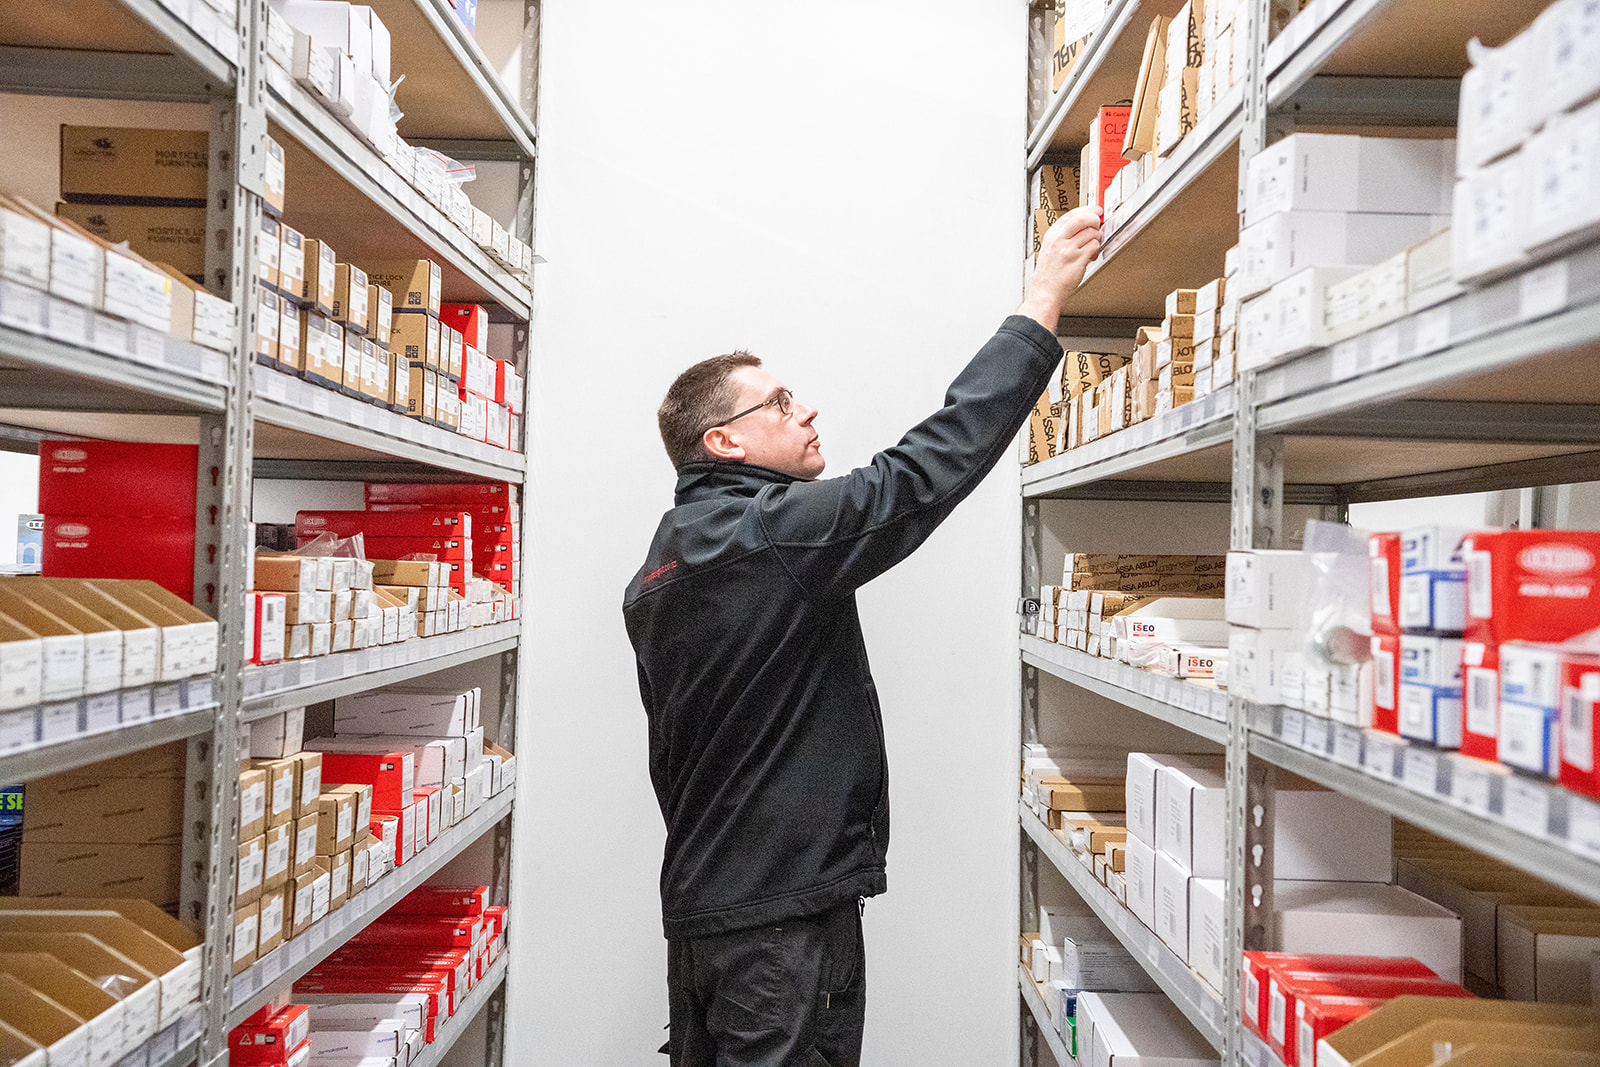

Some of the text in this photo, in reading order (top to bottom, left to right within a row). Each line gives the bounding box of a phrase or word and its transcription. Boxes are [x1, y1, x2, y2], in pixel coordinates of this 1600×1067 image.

[1116, 560, 1159, 574] ASSA ABLOY
[1194, 563, 1213, 572] ASSA
[1118, 579, 1160, 592] ASSA ABLOY
[1196, 582, 1215, 592] ASSA
[1133, 624, 1155, 632] ISEO
[1188, 659, 1213, 668] ISEO
